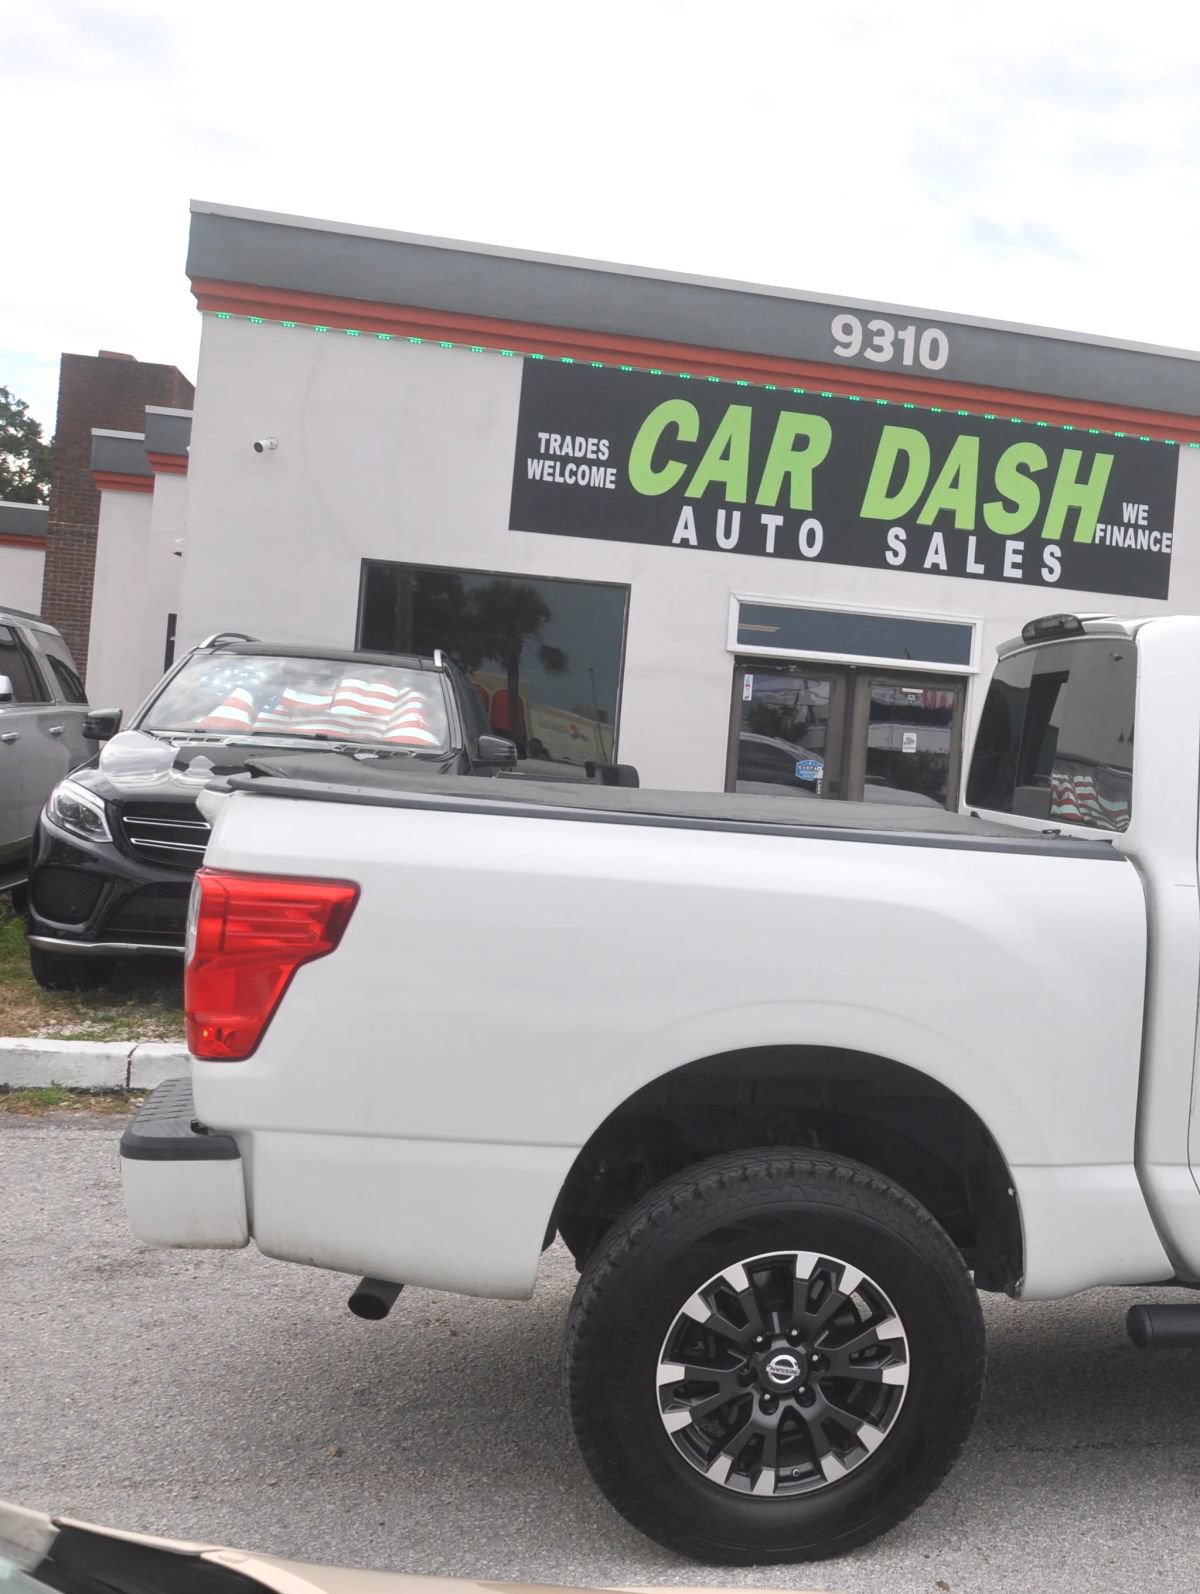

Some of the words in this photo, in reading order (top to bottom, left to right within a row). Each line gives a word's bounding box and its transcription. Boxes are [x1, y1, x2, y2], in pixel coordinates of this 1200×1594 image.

[830, 313, 950, 371] 9310
[537, 431, 610, 461] TRADES
[527, 457, 617, 490] WELCOME
[628, 398, 832, 511] CAR
[860, 425, 1114, 544] DASH
[1122, 502, 1149, 526] WE
[671, 505, 824, 558] AUTO
[885, 526, 1063, 583] SALES
[1094, 523, 1172, 554] FINANCE
